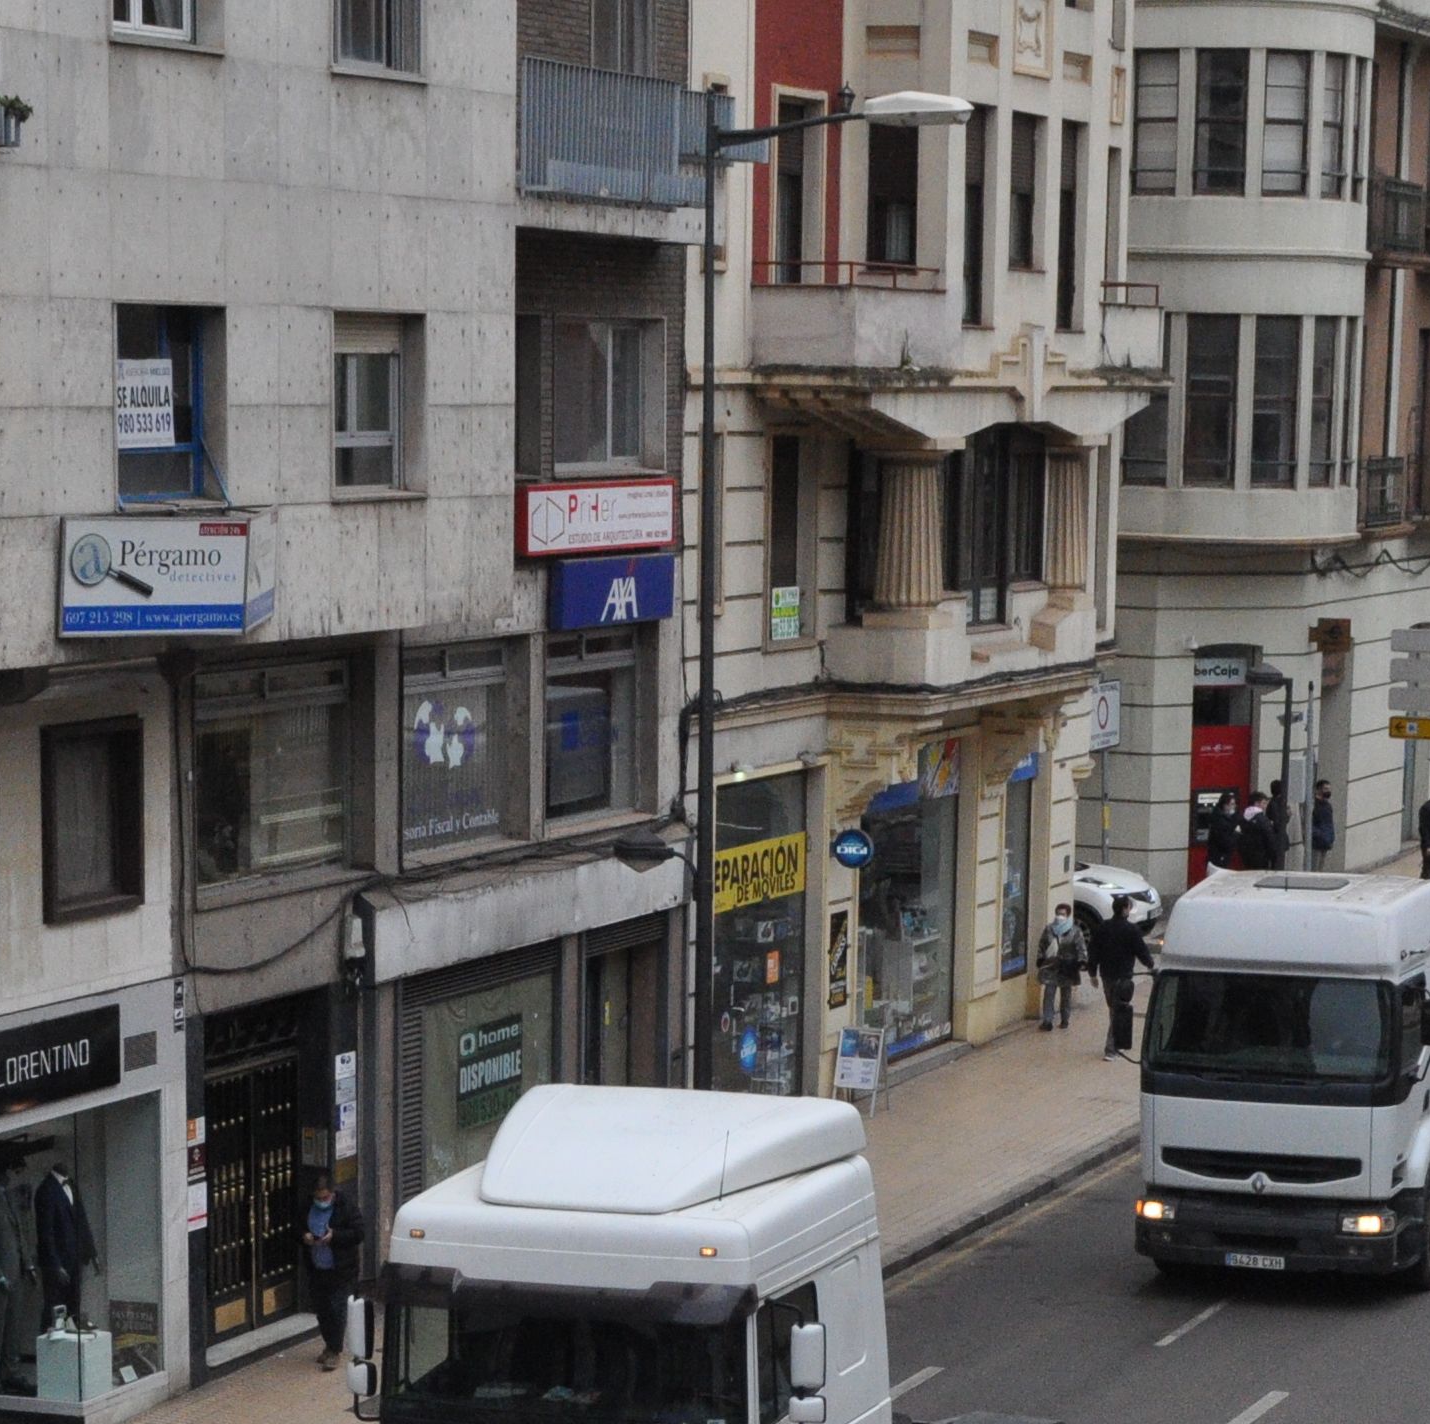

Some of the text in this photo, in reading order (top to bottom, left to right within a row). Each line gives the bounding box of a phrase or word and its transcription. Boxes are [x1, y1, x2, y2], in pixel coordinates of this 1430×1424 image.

[117, 385, 171, 408] SE ALQUILA
[118, 412, 171, 433] 980 533 619
[569, 533, 592, 544] ESTUDIO
[593, 532, 601, 542] DE
[121, 540, 221, 575] Pérgamo
[170, 571, 237, 582] detectives
[600, 576, 638, 622] AXA
[65, 612, 85, 625] 697
[89, 611, 109, 624] 215
[113, 611, 133, 624] 298
[145, 611, 241, 626] www.apergamo.es
[428, 815, 453, 836] Fiscal
[462, 808, 499, 828] Contable
[836, 845, 868, 855] DIGI
[737, 872, 796, 903] DE MÓVILES
[478, 1024, 519, 1047] home
[460, 1049, 522, 1094] DISPONIBLE
[1262, 1257, 1282, 1269] CXH
